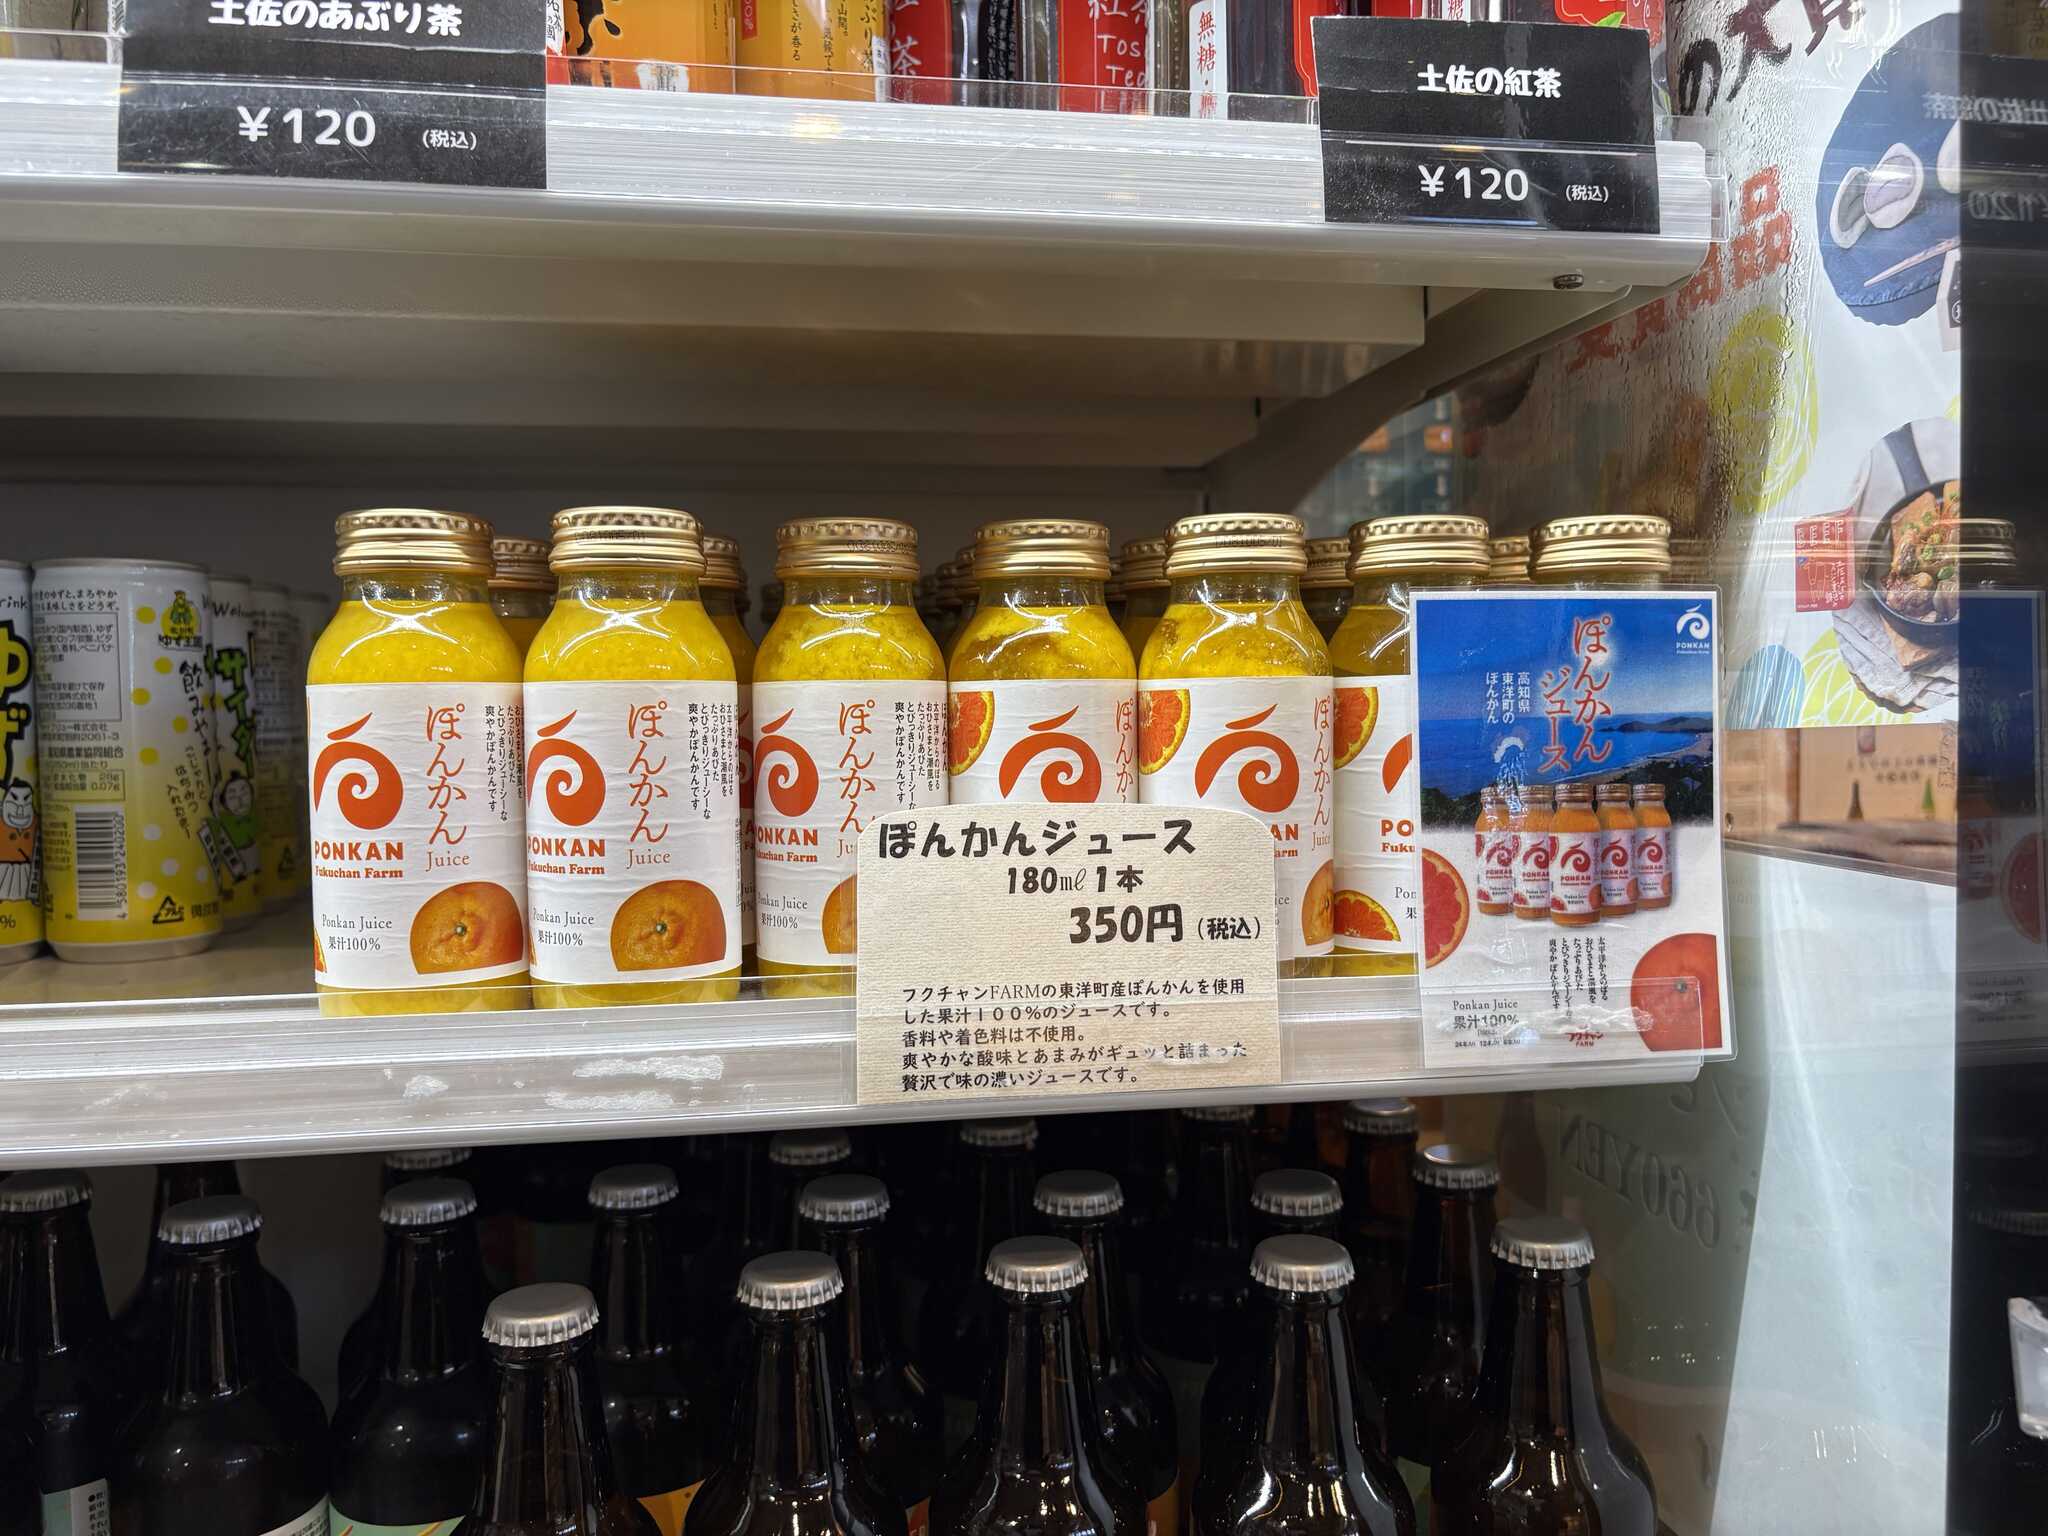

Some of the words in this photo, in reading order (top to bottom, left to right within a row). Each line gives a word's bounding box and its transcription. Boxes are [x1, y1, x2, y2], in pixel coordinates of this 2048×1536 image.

[209, 0, 463, 38] 土佐のあぶり茶
[1097, 34, 1146, 58] Tos
[1417, 63, 1562, 98] 土佐の紅茶
[237, 106, 377, 149] ¥120
[422, 129, 478, 153] (税込)
[1418, 164, 1530, 202] ¥120
[1565, 183, 1610, 205] (税込)
[1502, 671, 1515, 724] 東洋町の
[1517, 671, 1531, 713] 高知県
[1572, 615, 1613, 761] ぽんかん
[1538, 667, 1572, 773] ジュース
[1115, 697, 1134, 804] ぽんか
[1313, 695, 1331, 827] ぽんかん
[426, 702, 467, 845] ぽんかん
[628, 701, 669, 843] ぽんかん
[757, 827, 819, 846] ONKAN
[878, 819, 1197, 859] ぽんかんジュース
[315, 840, 404, 861] PONKAN
[425, 851, 471, 872] Juice
[626, 849, 671, 869] Juice
[786, 851, 818, 863] Farm
[1275, 849, 1299, 858] arm
[365, 867, 404, 879] Farm
[569, 863, 605, 875] Farm
[782, 896, 808, 911] Juice
[322, 913, 355, 929] Ponkan
[359, 916, 393, 932] Juice
[564, 911, 595, 927] Juice
[1069, 903, 1184, 944] 350円
[1197, 915, 1262, 941] (税込)
[328, 935, 381, 951] 果汁100%
[537, 929, 583, 946] 果汁100%
[902, 978, 1246, 1003] フクチャンFARMの東洋町産ぽんかんを使用
[903, 1002, 1172, 1025] した果汁100%のジュースです。
[1453, 1000, 1490, 1010] Ponkan
[1493, 999, 1519, 1012] Juice
[902, 1024, 1087, 1047] 香料や着色料は不使用。
[902, 1043, 1248, 1071] 爽やかな酸味とあまみがギュッと詰まった
[902, 1066, 1139, 1093] 贅沢で味の濃いジュースです。
